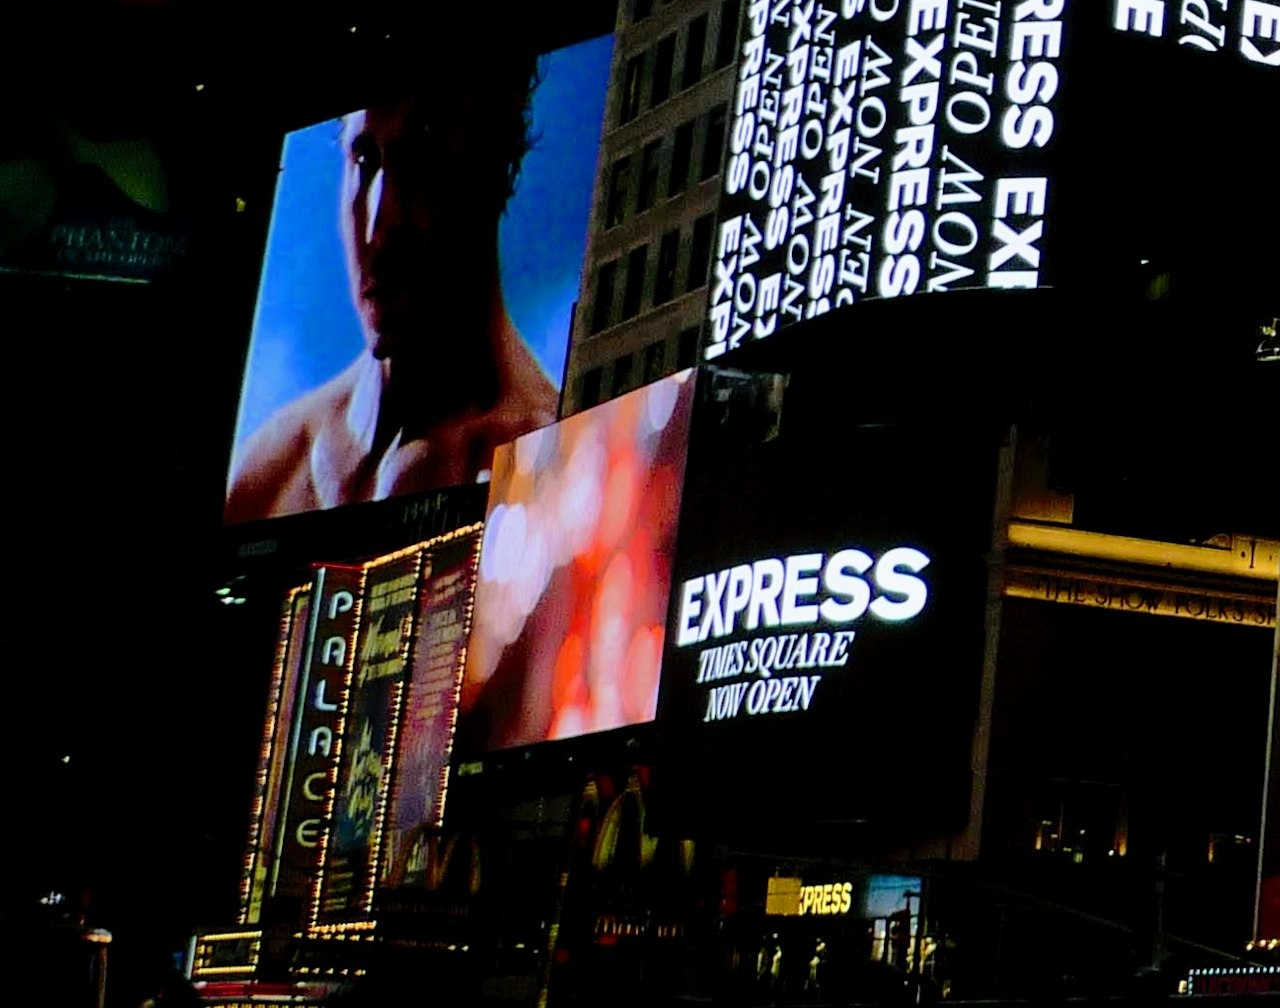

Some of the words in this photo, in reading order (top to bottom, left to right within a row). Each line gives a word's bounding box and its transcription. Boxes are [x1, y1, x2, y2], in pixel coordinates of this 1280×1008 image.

[750, 46, 786, 202] OPEN
[781, 172, 816, 322] NOW
[800, 3, 838, 161] OPEN
[851, 34, 894, 185] NOW
[677, 547, 931, 648] EXPRESS
[695, 640, 750, 684] TIMES
[744, 630, 856, 678] SQUARE
[1097, 587, 1160, 611] SHOW
[1174, 594, 1245, 623] FOLKS
[294, 589, 355, 849] PALACE
[703, 681, 750, 723] NOW
[747, 675, 822, 716] OPEN
